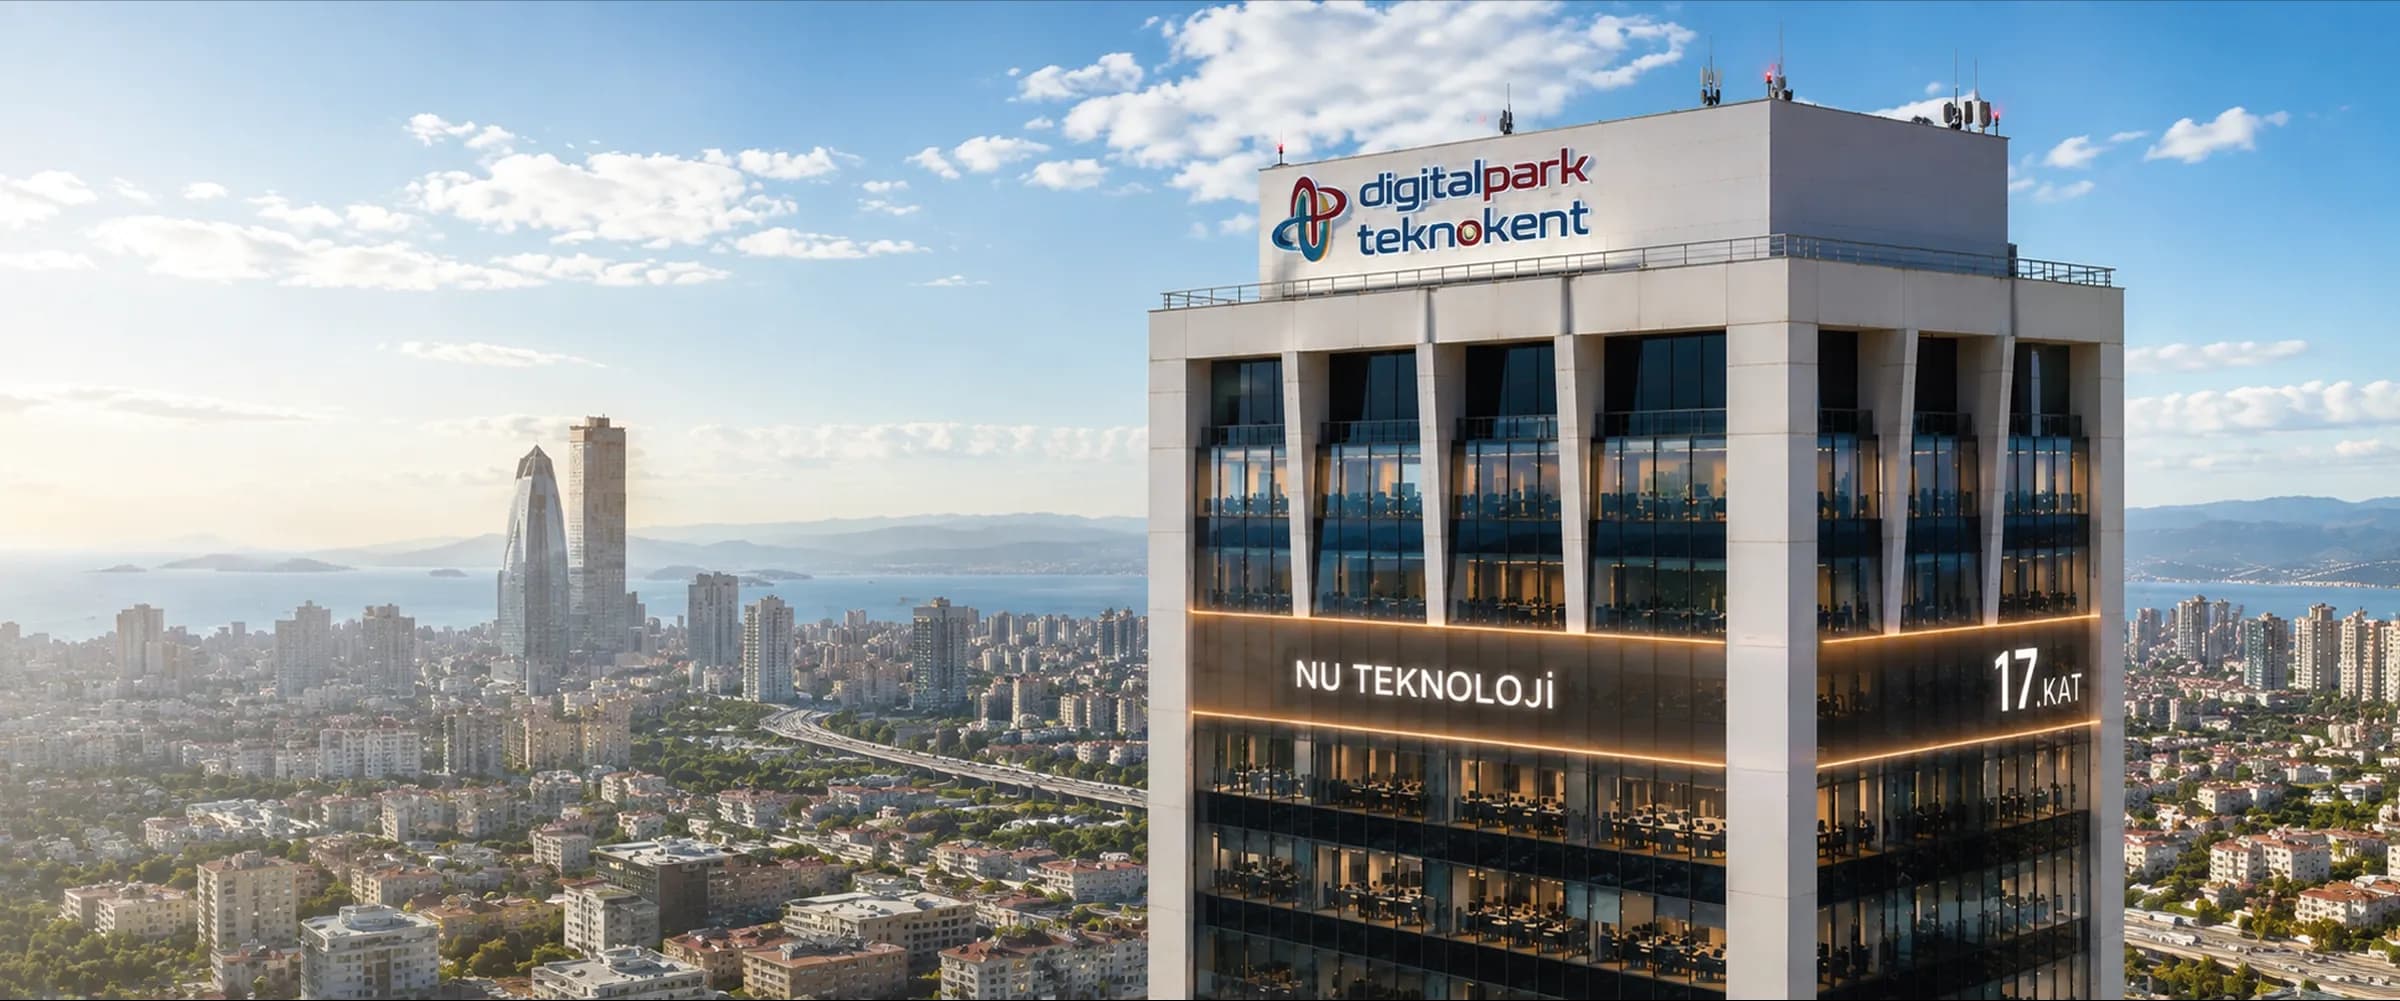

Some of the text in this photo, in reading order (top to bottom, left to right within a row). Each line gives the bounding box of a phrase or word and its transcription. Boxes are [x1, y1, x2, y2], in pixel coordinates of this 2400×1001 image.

[1359, 147, 1590, 212] digitalpark
[1356, 200, 1590, 257] teknokent
[1295, 659, 1341, 692] NU
